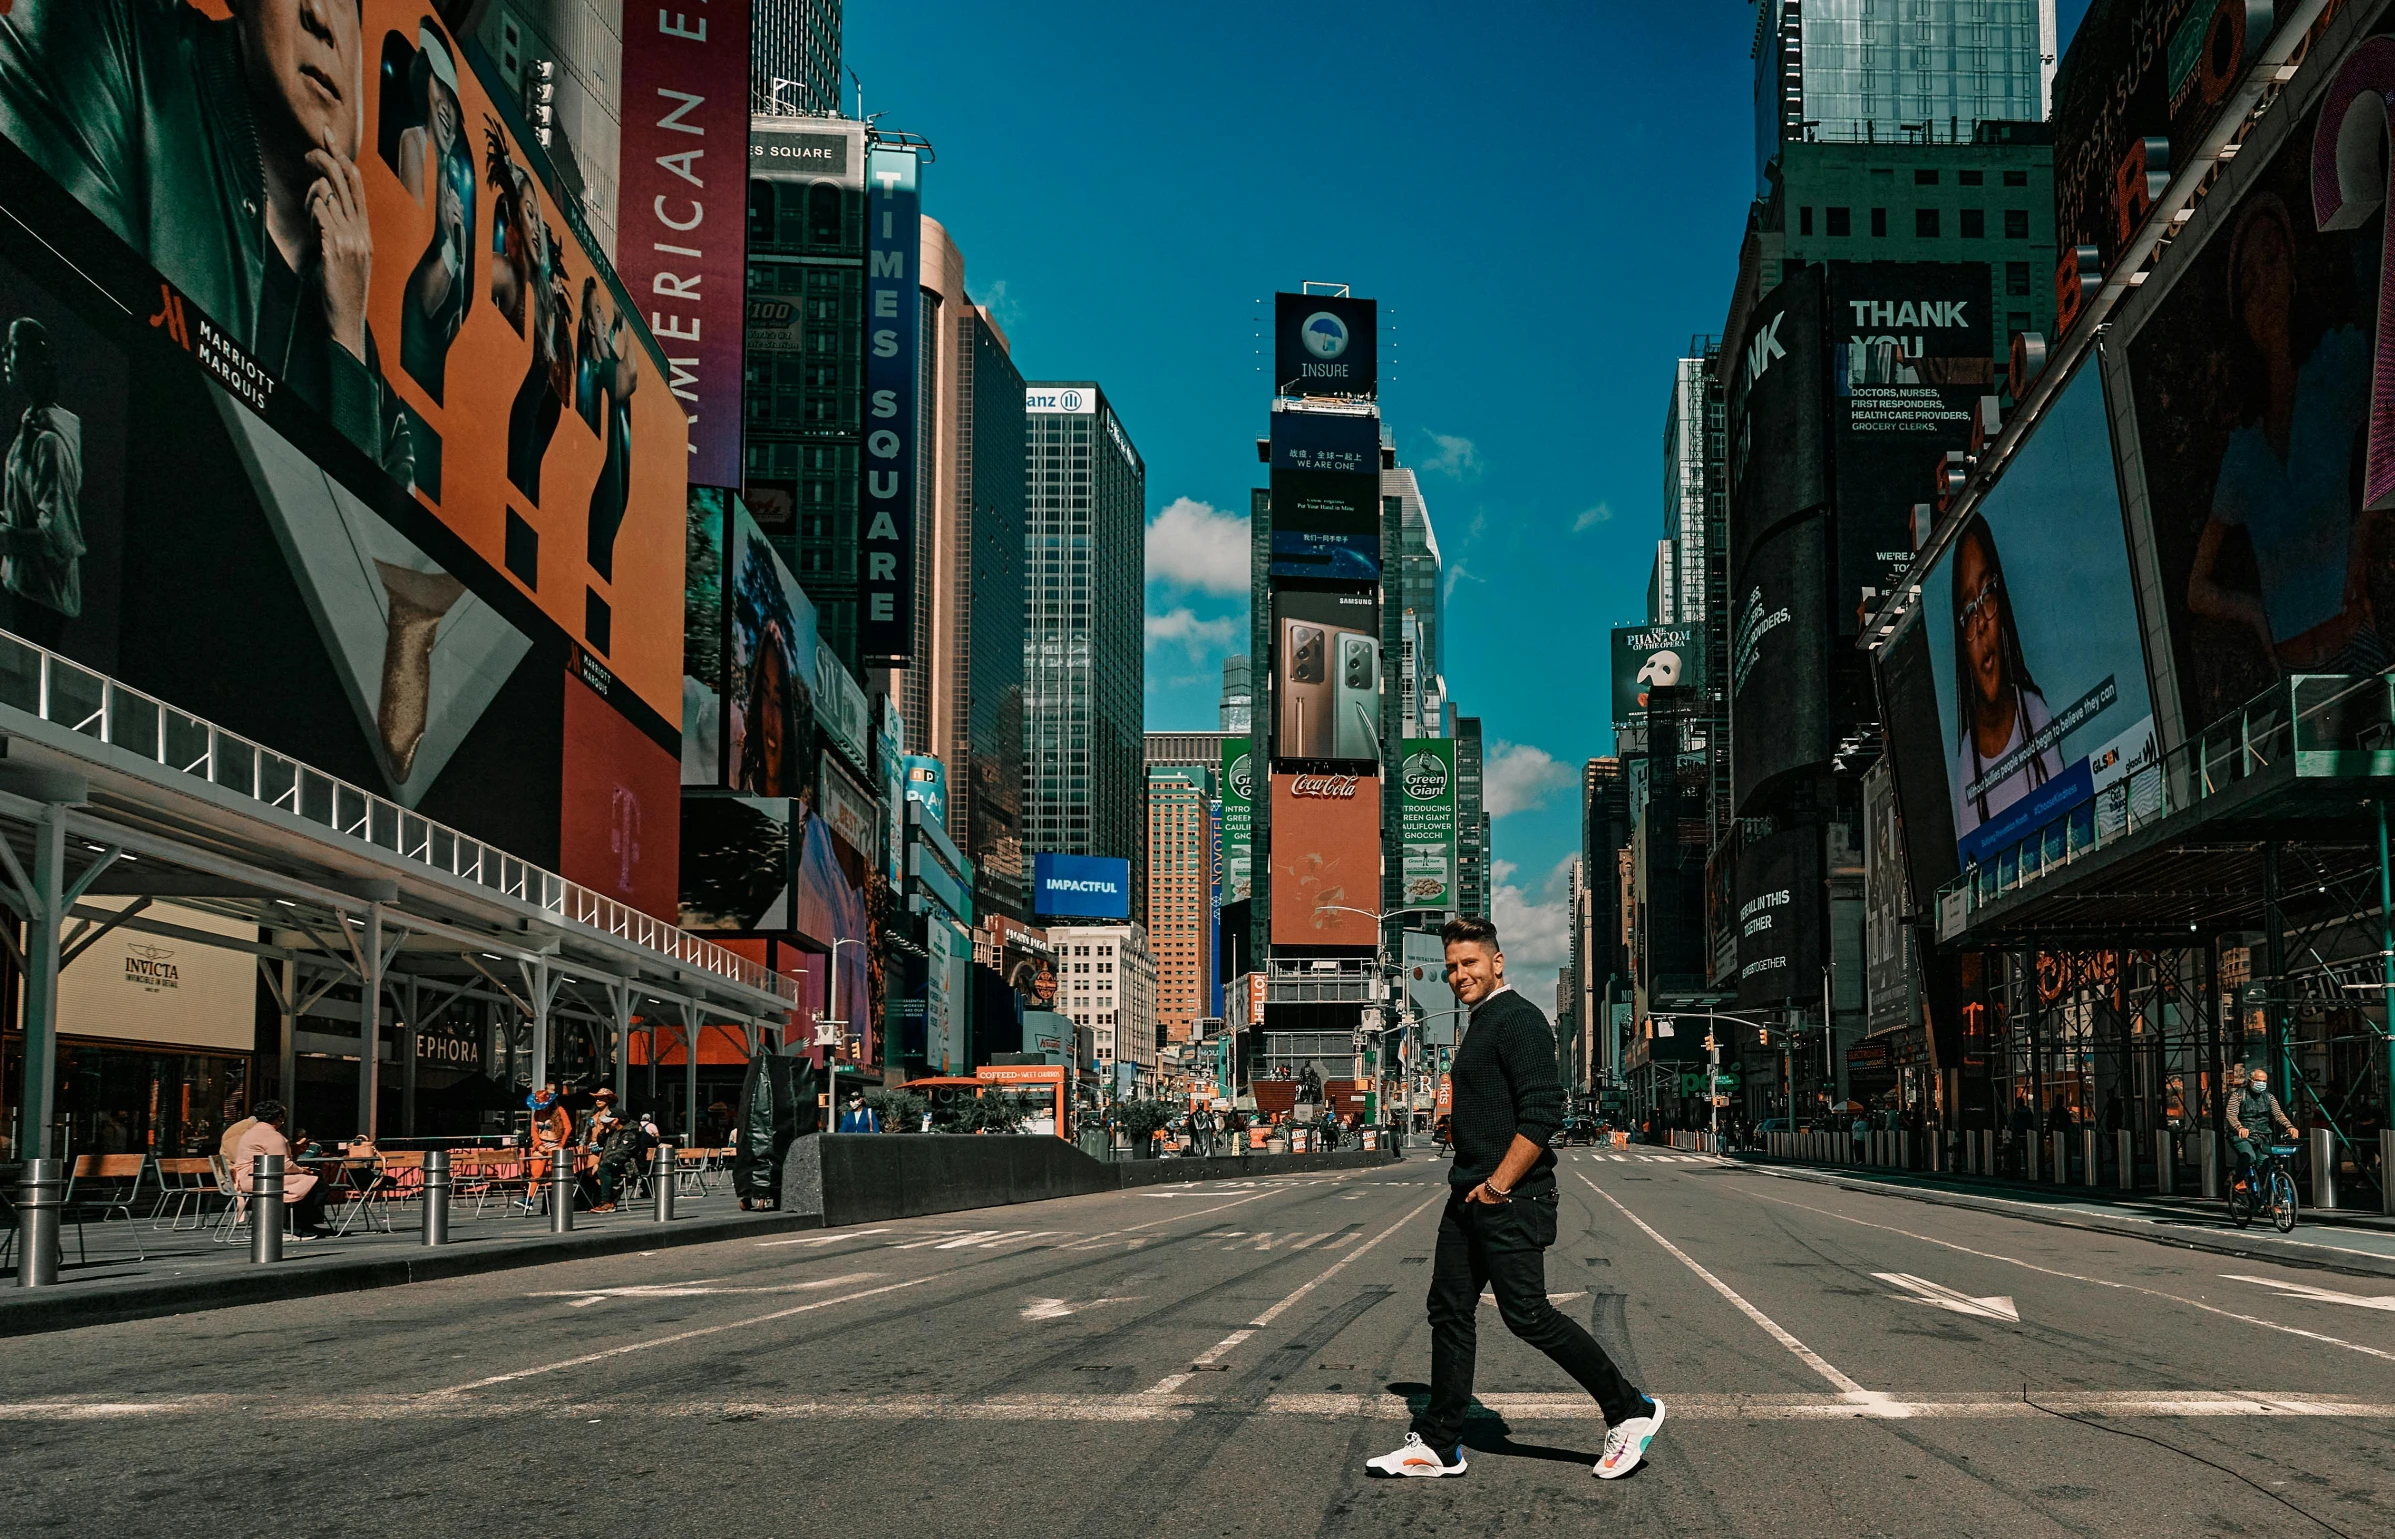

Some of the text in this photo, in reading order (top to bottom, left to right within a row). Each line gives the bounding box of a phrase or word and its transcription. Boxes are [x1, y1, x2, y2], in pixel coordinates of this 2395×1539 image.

[770, 146, 833, 159] SQUARE
[571, 207, 612, 280] MARRIOTT
[1850, 300, 1969, 328] THANK
[200, 320, 275, 394] MARRIOTT
[199, 344, 266, 409] MARQUIS
[1301, 363, 1349, 378] INSURE
[866, 171, 904, 622] TIMES SQUARE
[1851, 388, 1940, 398] DOCTORS, NURSES,
[1851, 400, 1945, 410] FIRST RESPONDERS,
[1851, 411, 1971, 421] HEALTH CARE PROVIDERS,
[1852, 422, 1897, 431] GROCERY
[1297, 460, 1355, 471] WE ARE ONE
[1876, 551, 1908, 561] WE'RE
[1339, 597, 1373, 606] SAMSUNG
[1650, 626, 1667, 634] THE
[1626, 630, 1691, 646] PHANTOM
[1632, 641, 1686, 651] OF THE OPERA
[1967, 684, 2115, 801] Without bullies people would begin to believe they can
[2092, 746, 2120, 775] GLSEN
[2125, 752, 2143, 774] glaad
[1405, 773, 1445, 784] Green
[1291, 774, 1358, 800] Coca-Cola
[1410, 785, 1446, 796] Giant
[1404, 831, 1443, 839] GNOCCHI
[1046, 878, 1118, 894] IMPACTFUL
[1766, 889, 1790, 908] THIS
[126, 957, 178, 979] INVICTA
[416, 1034, 479, 1063] EPHORA
[980, 1071, 1017, 1079] COFFEED
[1439, 1083, 1449, 1105] tkts
